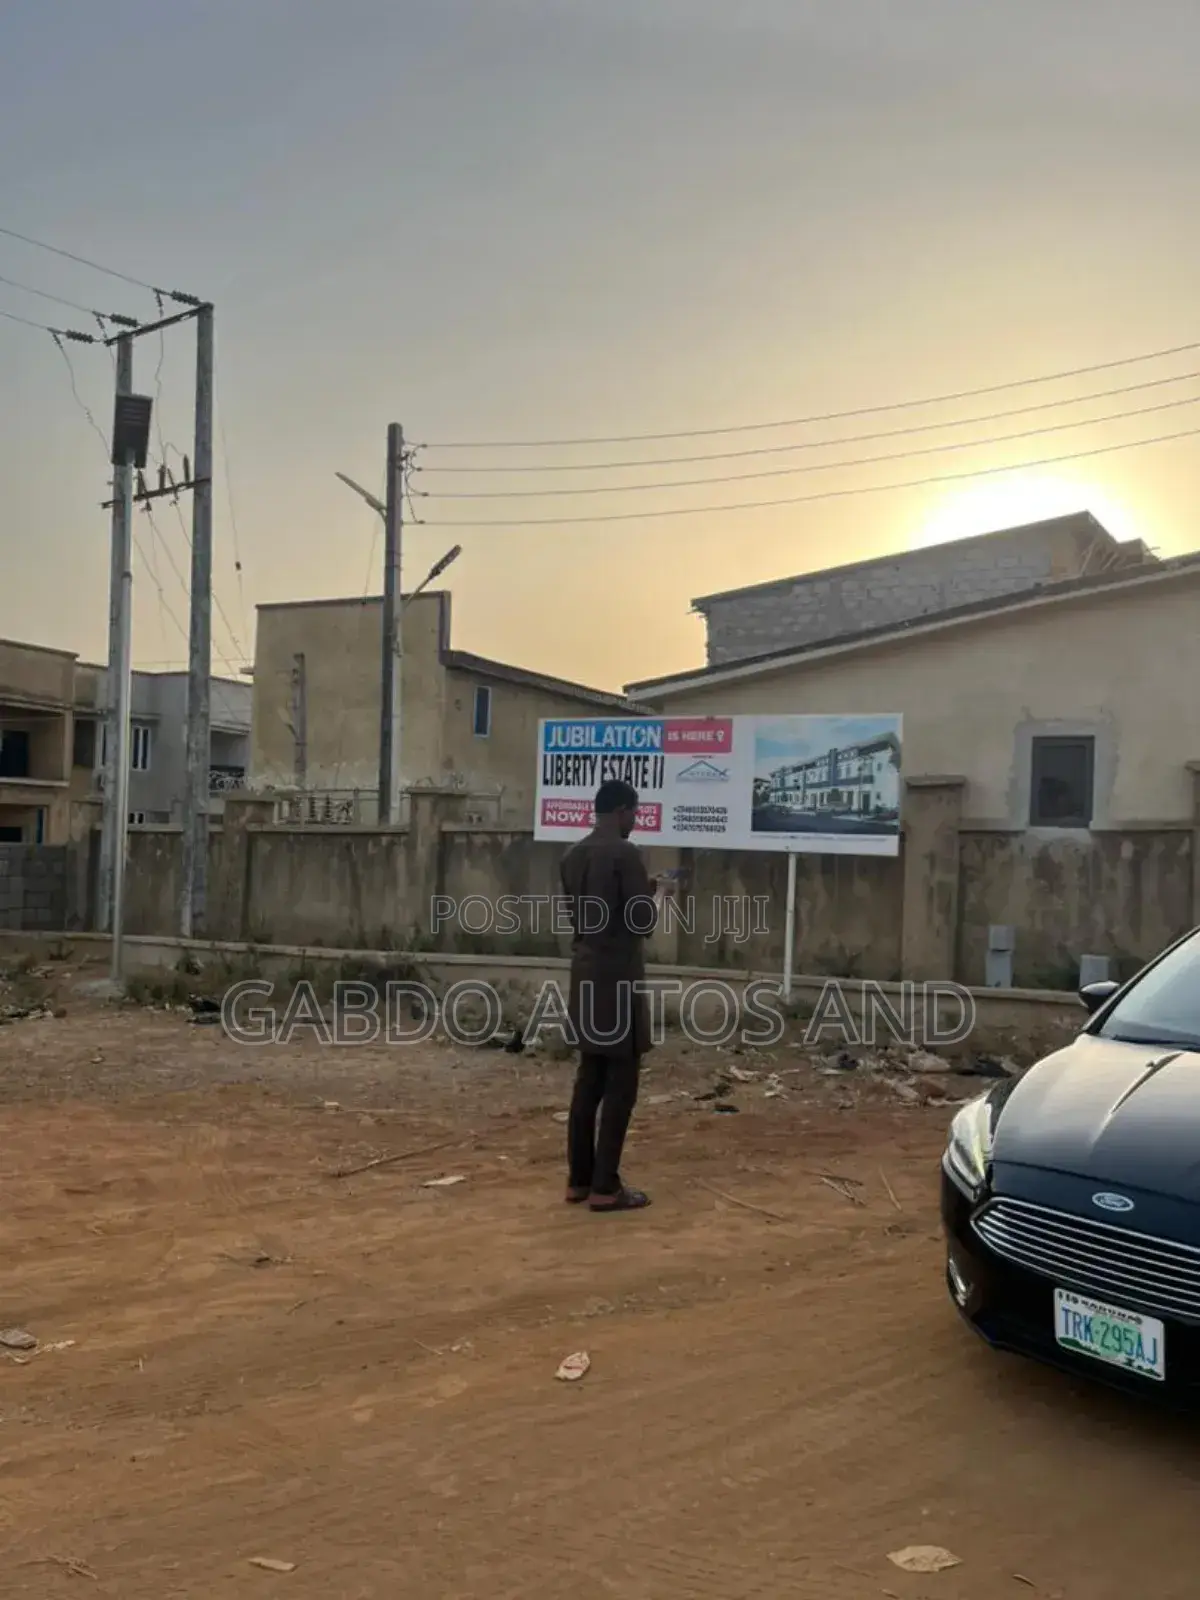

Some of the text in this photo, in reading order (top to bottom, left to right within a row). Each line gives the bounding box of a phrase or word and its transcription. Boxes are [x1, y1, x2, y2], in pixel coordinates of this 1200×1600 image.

[547, 724, 714, 748] JUBILATION IS HERE
[543, 754, 597, 787] LIBERTY
[601, 754, 649, 789] ESTATE
[545, 811, 584, 823] NOW
